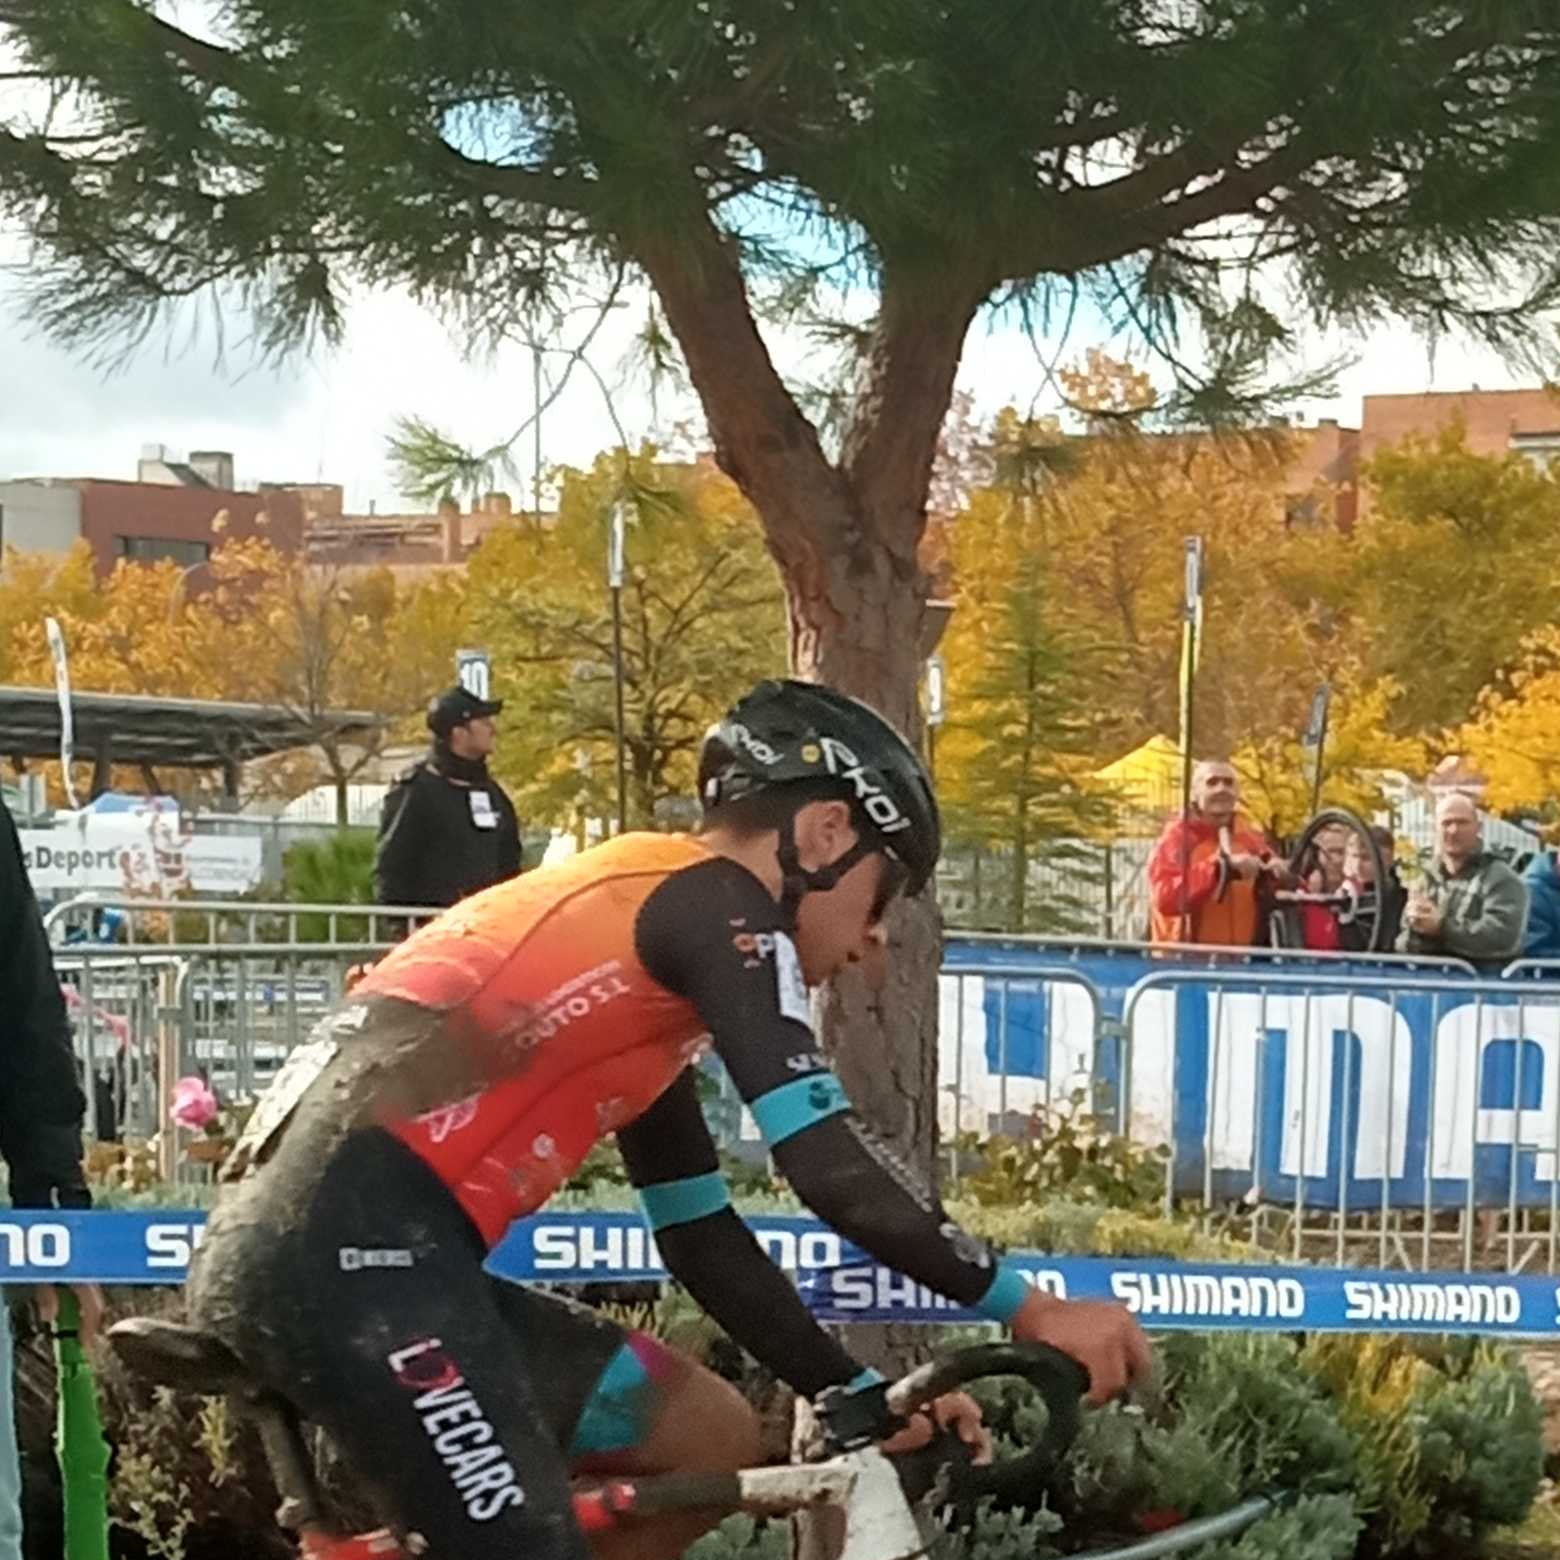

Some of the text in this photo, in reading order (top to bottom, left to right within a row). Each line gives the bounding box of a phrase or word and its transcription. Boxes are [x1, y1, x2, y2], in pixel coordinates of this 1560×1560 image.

[1110, 1271, 1305, 1318] SHIMANO
[1344, 1281, 1521, 1324] SHIMANO
[387, 1337, 526, 1521] LOVECARS
